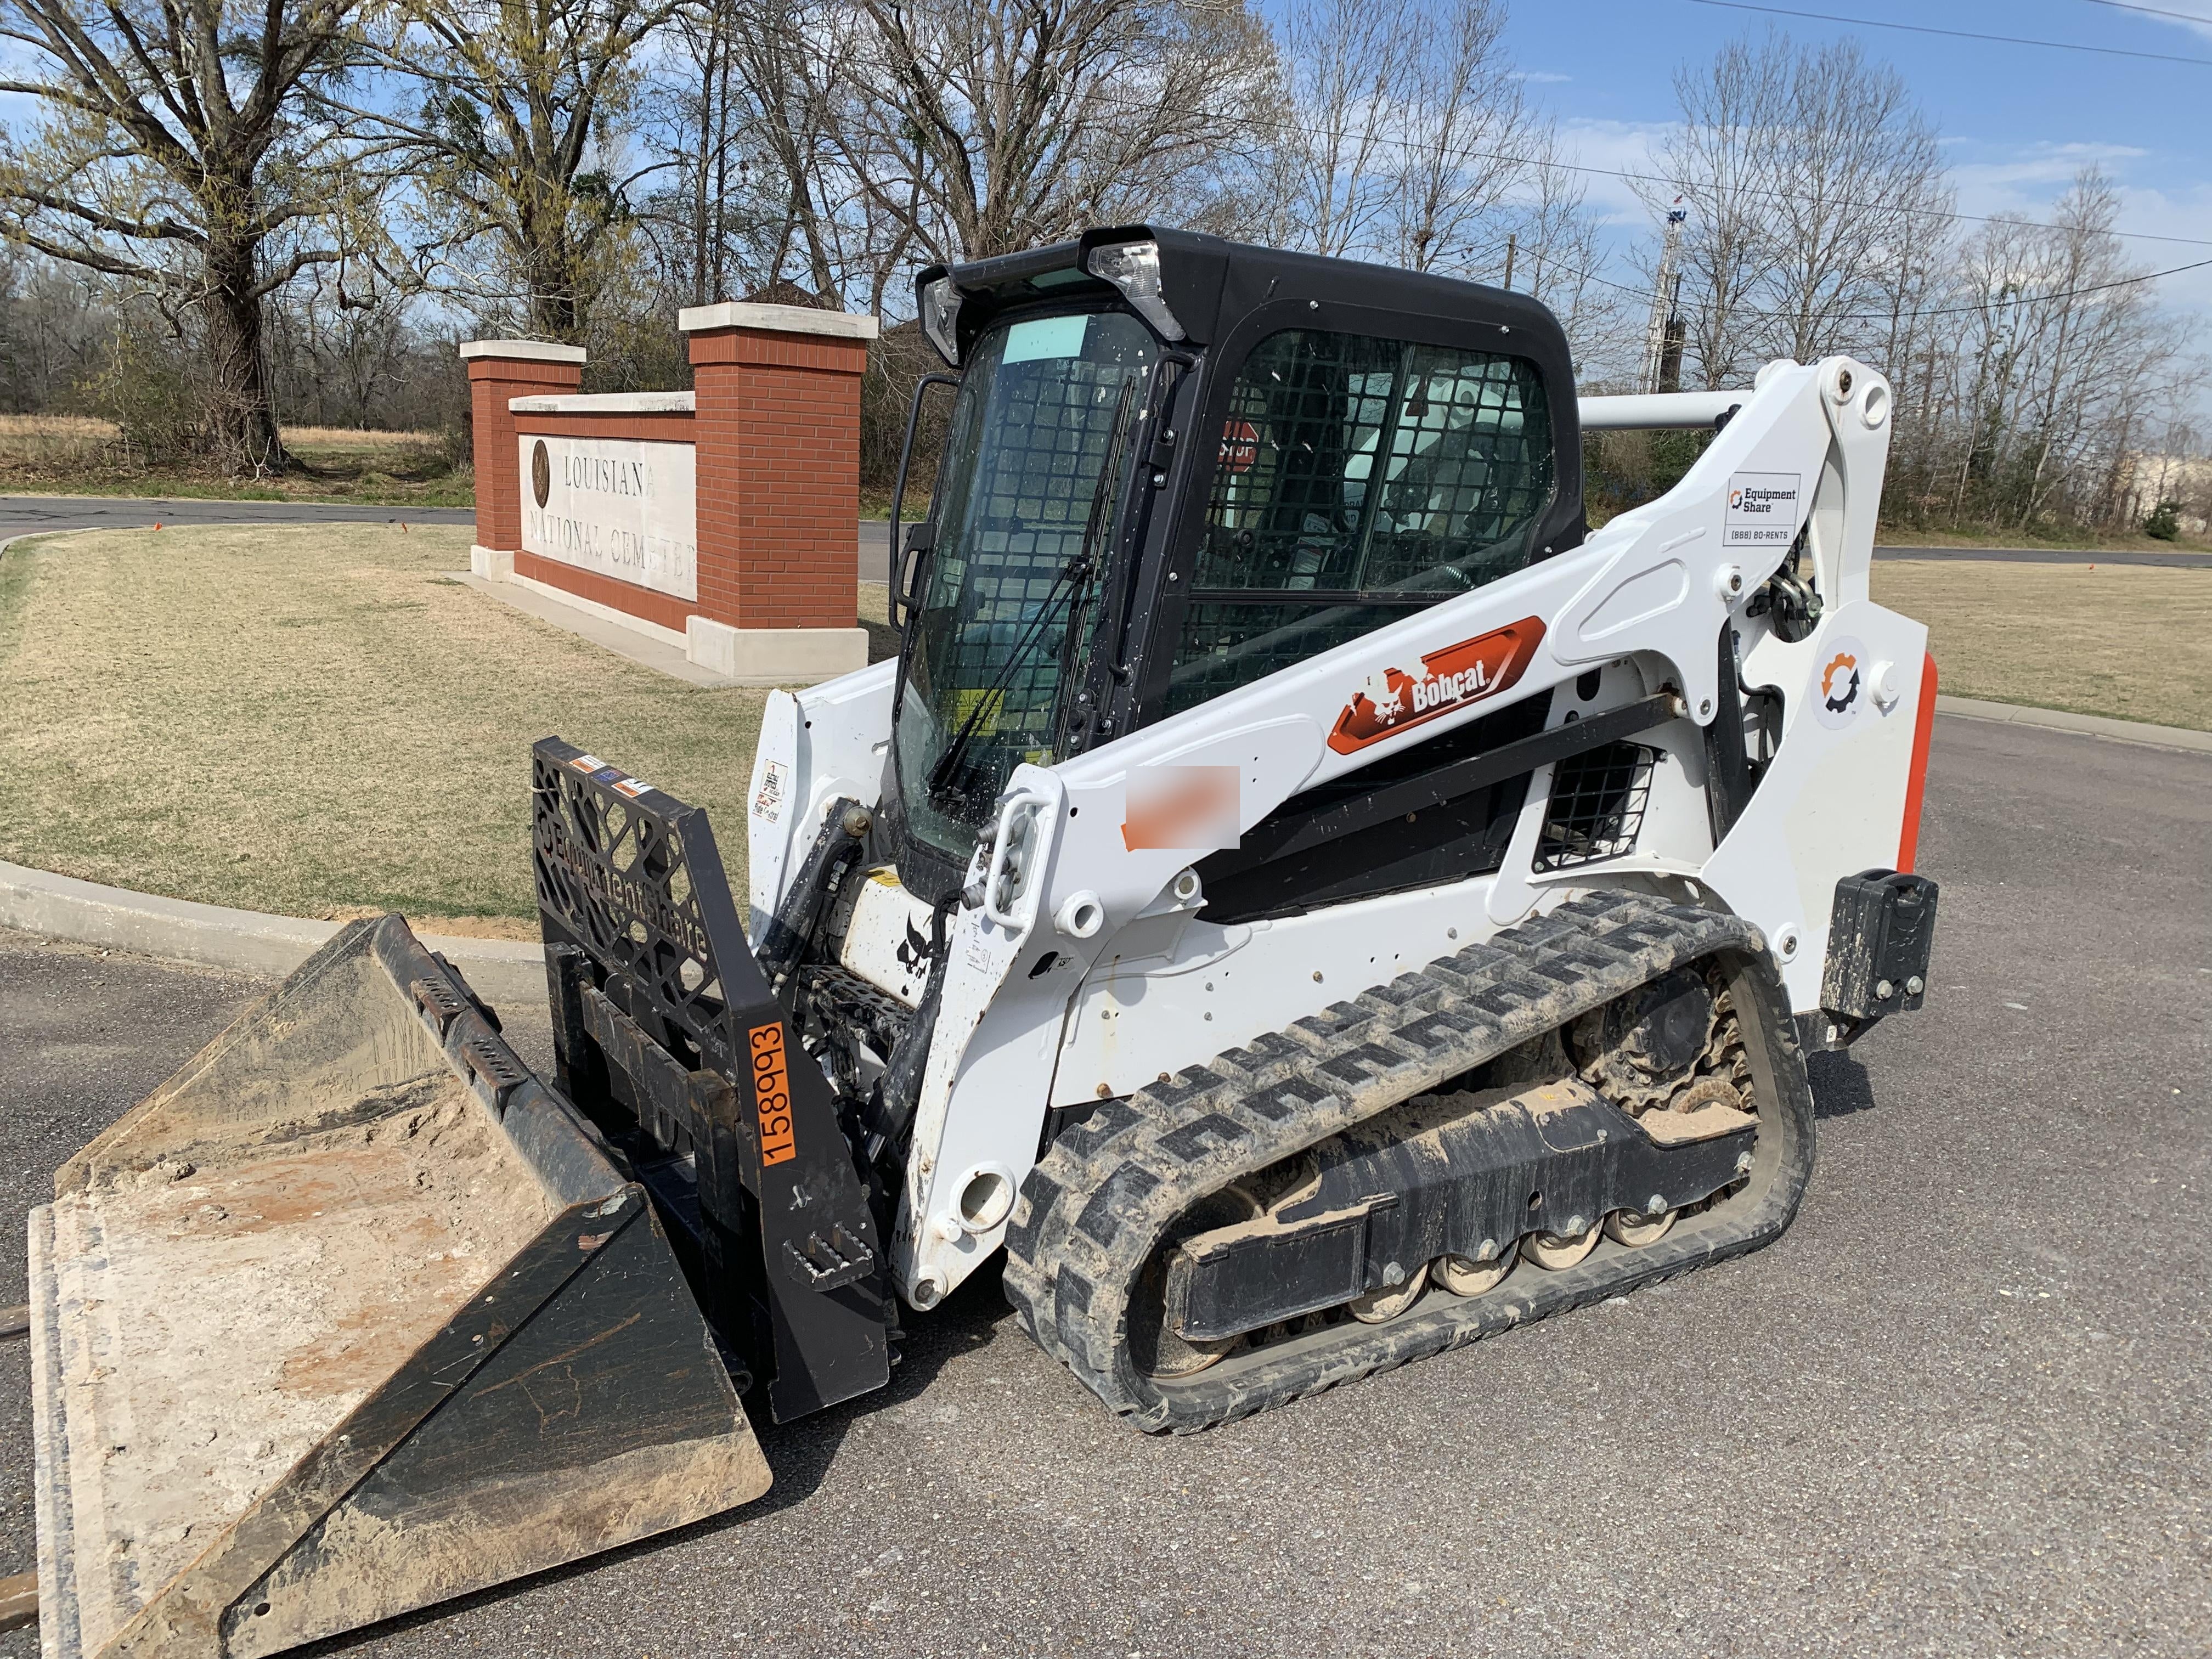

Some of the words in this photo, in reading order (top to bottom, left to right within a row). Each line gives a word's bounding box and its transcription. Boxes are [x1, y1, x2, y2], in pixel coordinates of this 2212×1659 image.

[565, 456, 656, 498] LOUISIANA
[1745, 488, 1796, 501] Equipment
[1743, 501, 1771, 512] Share
[530, 510, 602, 557] NATIONAL
[1731, 530, 1752, 540] (888)
[1753, 531, 1788, 540] 80-RENTS
[1411, 659, 1486, 713] Bobcat
[751, 1026, 793, 1159] 158993
